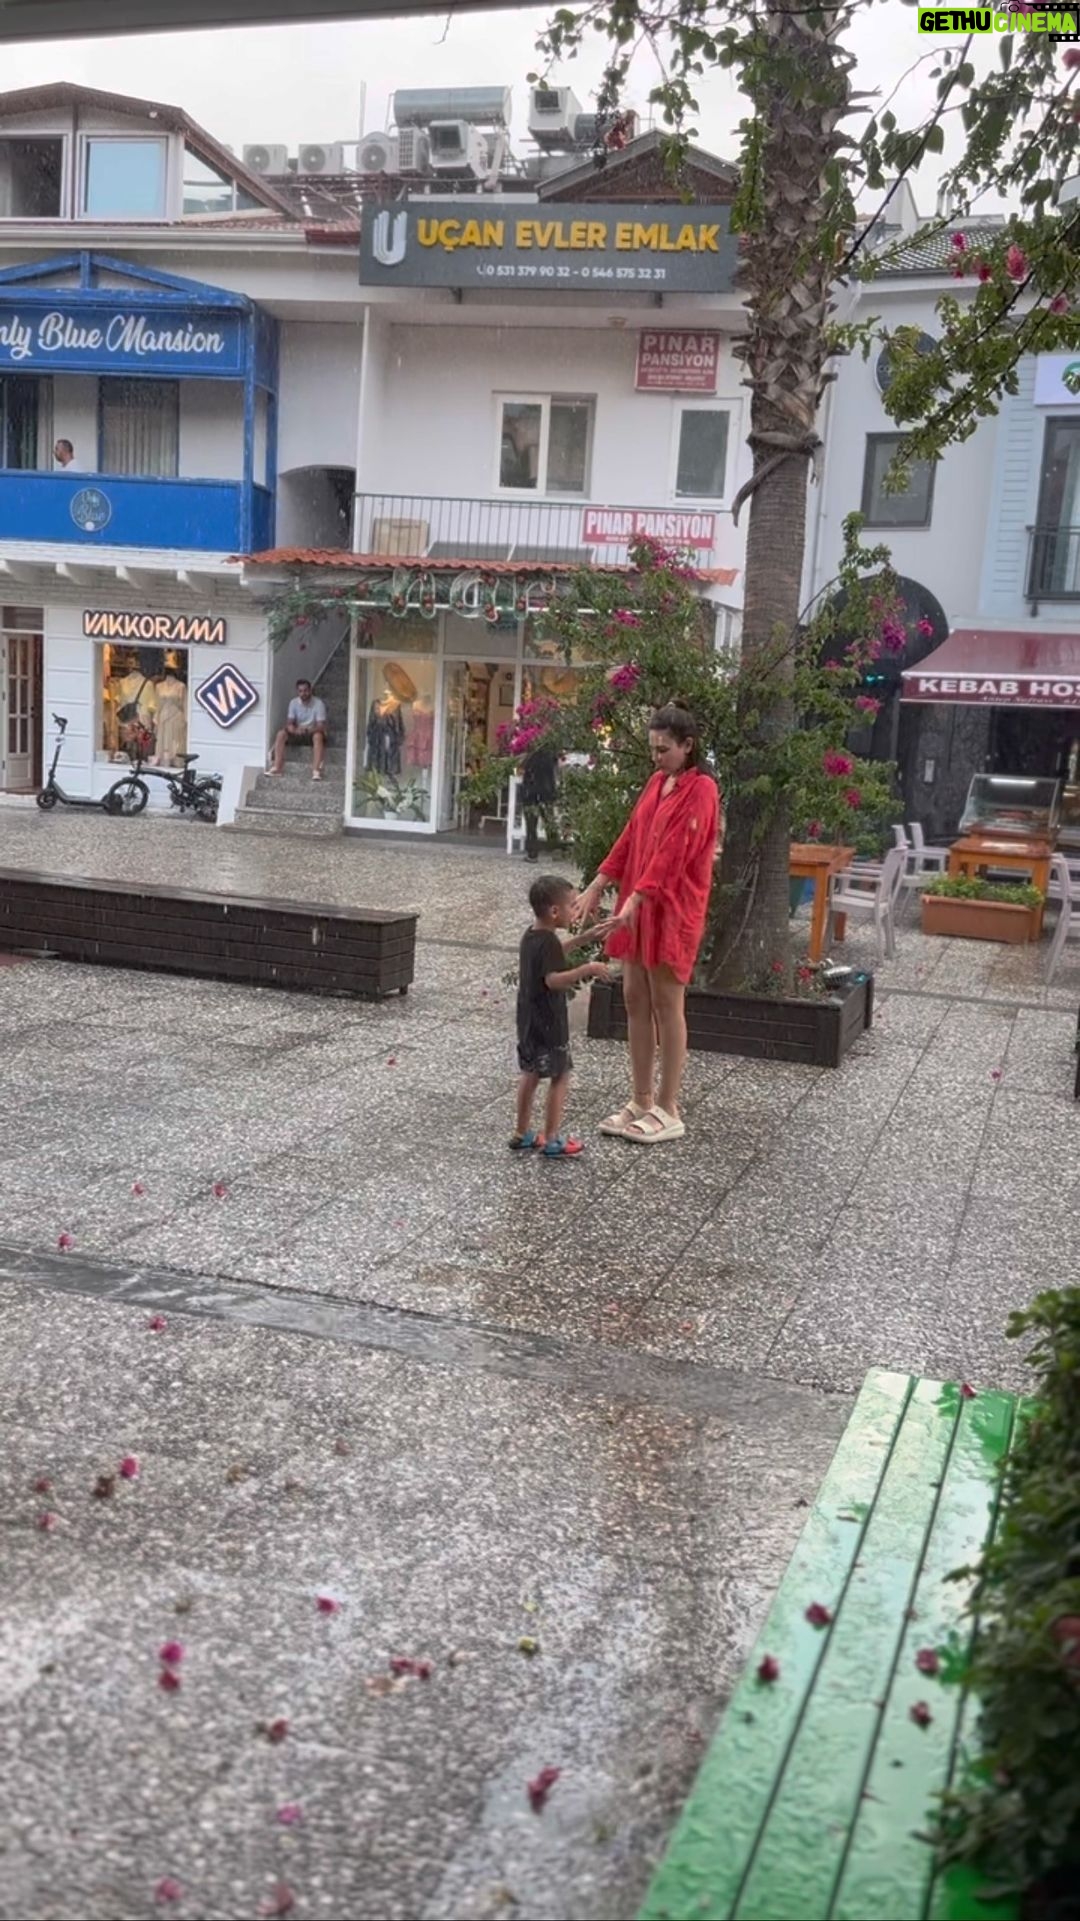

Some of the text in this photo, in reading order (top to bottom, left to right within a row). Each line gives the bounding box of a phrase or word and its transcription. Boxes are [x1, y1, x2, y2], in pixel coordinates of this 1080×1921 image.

[417, 218, 720, 252] UÇAN EVLER EMLAK
[486, 265, 494, 276] 0
[497, 265, 515, 276] 531
[517, 265, 537, 277] 379
[539, 266, 554, 277] 90
[556, 266, 570, 277] 32
[581, 267, 590, 278] 0
[592, 267, 614, 278] 546
[616, 268, 635, 279] 575
[637, 268, 651, 279] 32
[653, 268, 666, 279] 31
[37, 311, 103, 351] Blue
[105, 314, 224, 355] Mansion
[643, 334, 715, 353] PINAR
[586, 511, 633, 535] PINAR
[84, 612, 224, 643] VAKKORAMA
[918, 679, 1018, 695] KEBAB
